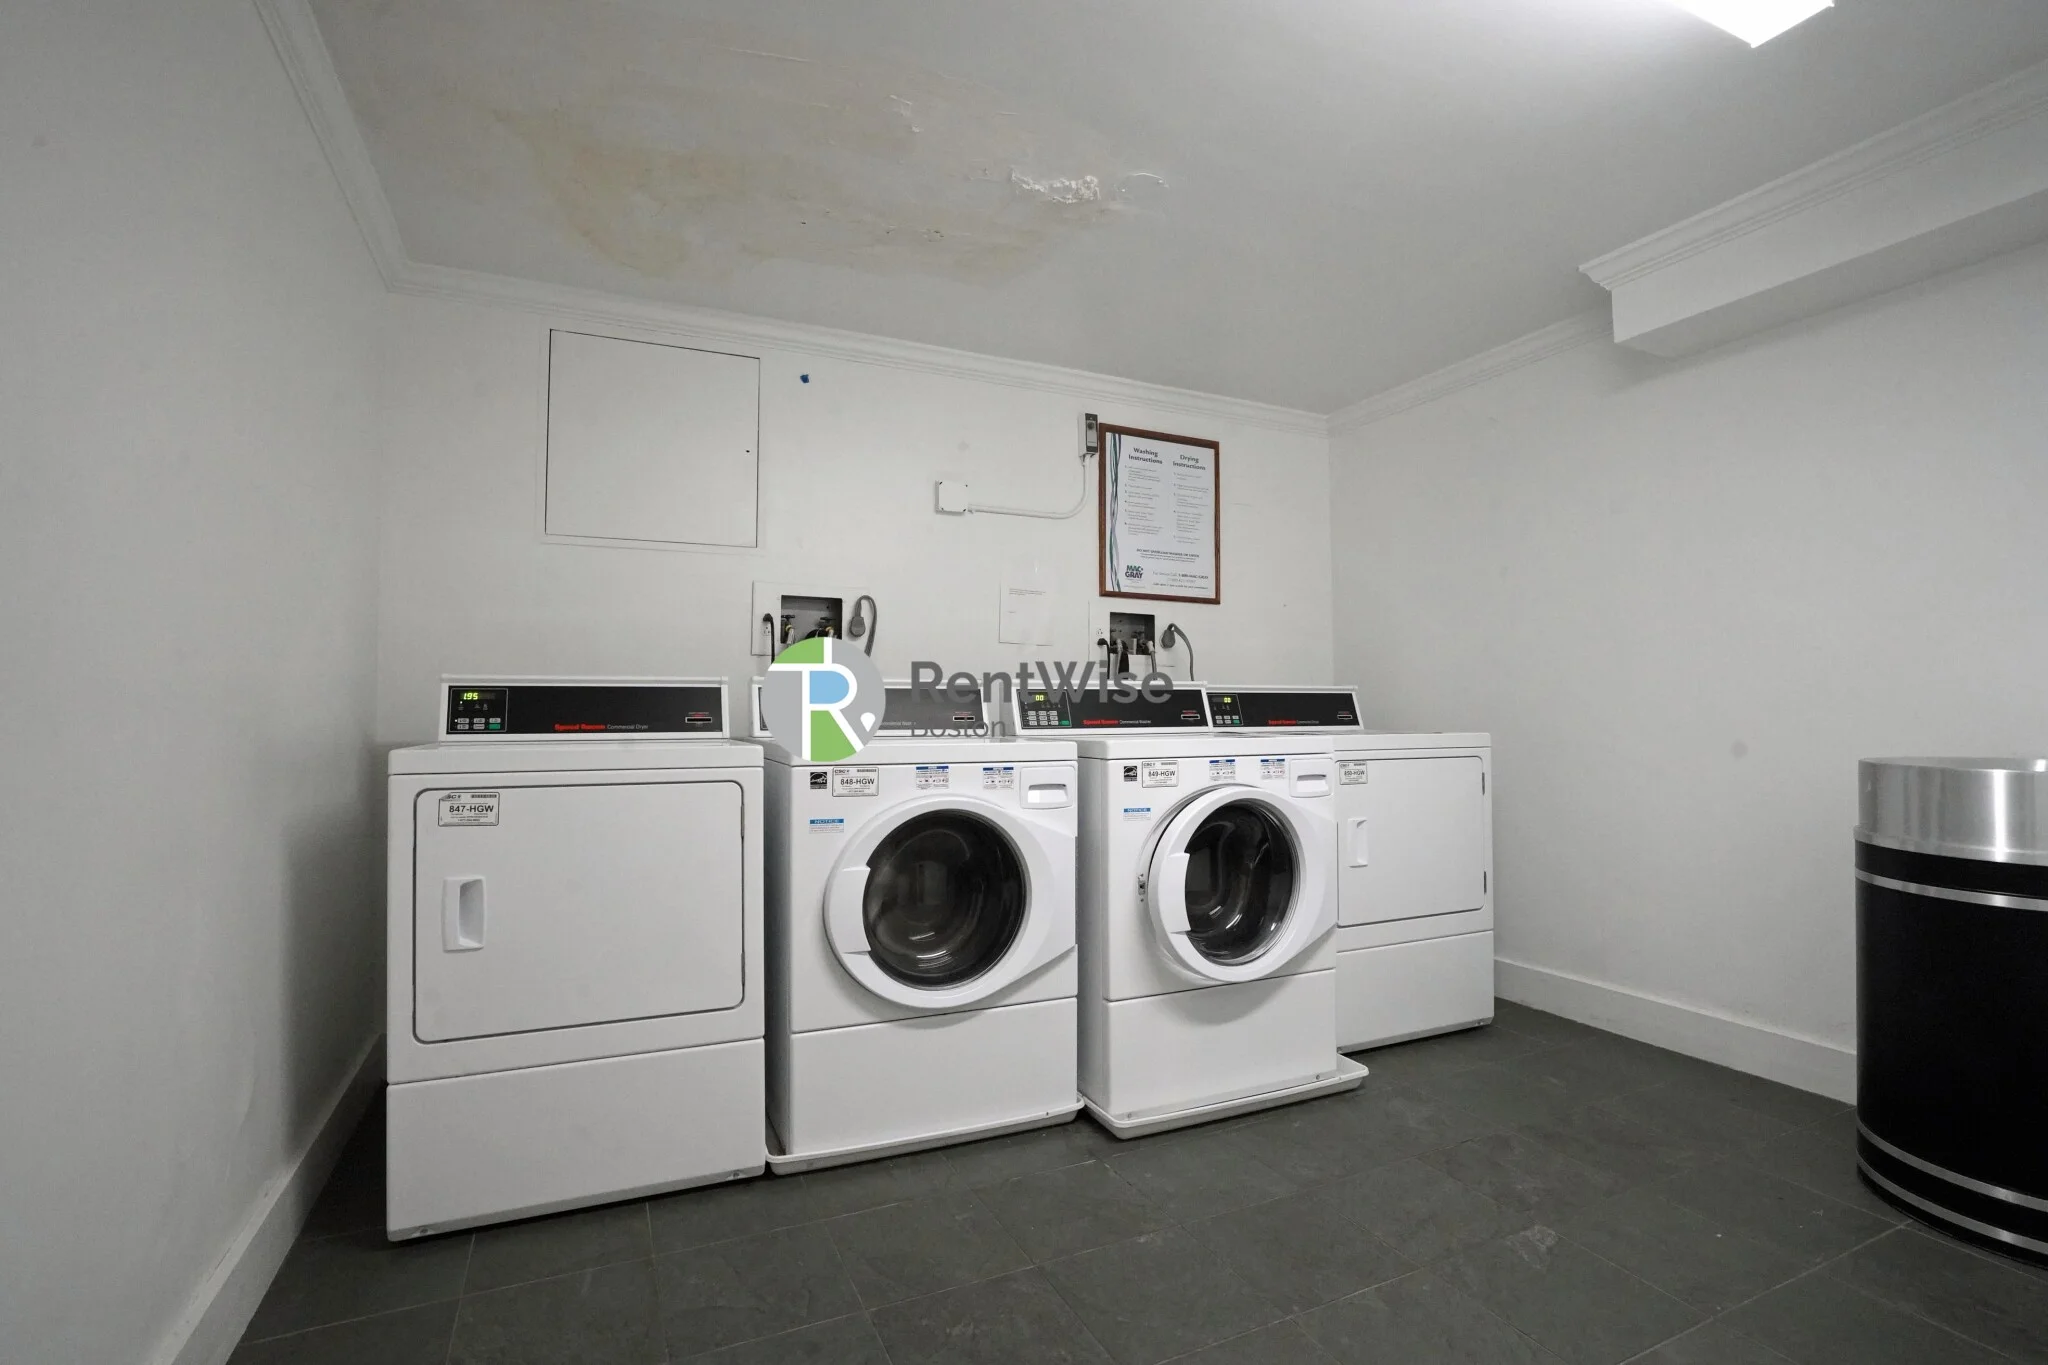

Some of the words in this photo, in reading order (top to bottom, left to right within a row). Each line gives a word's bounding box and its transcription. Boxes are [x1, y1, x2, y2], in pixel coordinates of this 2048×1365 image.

[1133, 447, 1159, 457] Washing
[1128, 454, 1163, 465] Instructions
[1179, 454, 1199, 463] Drying
[1172, 461, 1206, 470] Instructions
[1124, 571, 1143, 579] GRAY
[1148, 770, 1176, 778] 849-HGW
[840, 778, 875, 786] 848-HGW
[449, 805, 494, 813] 847-HGW
